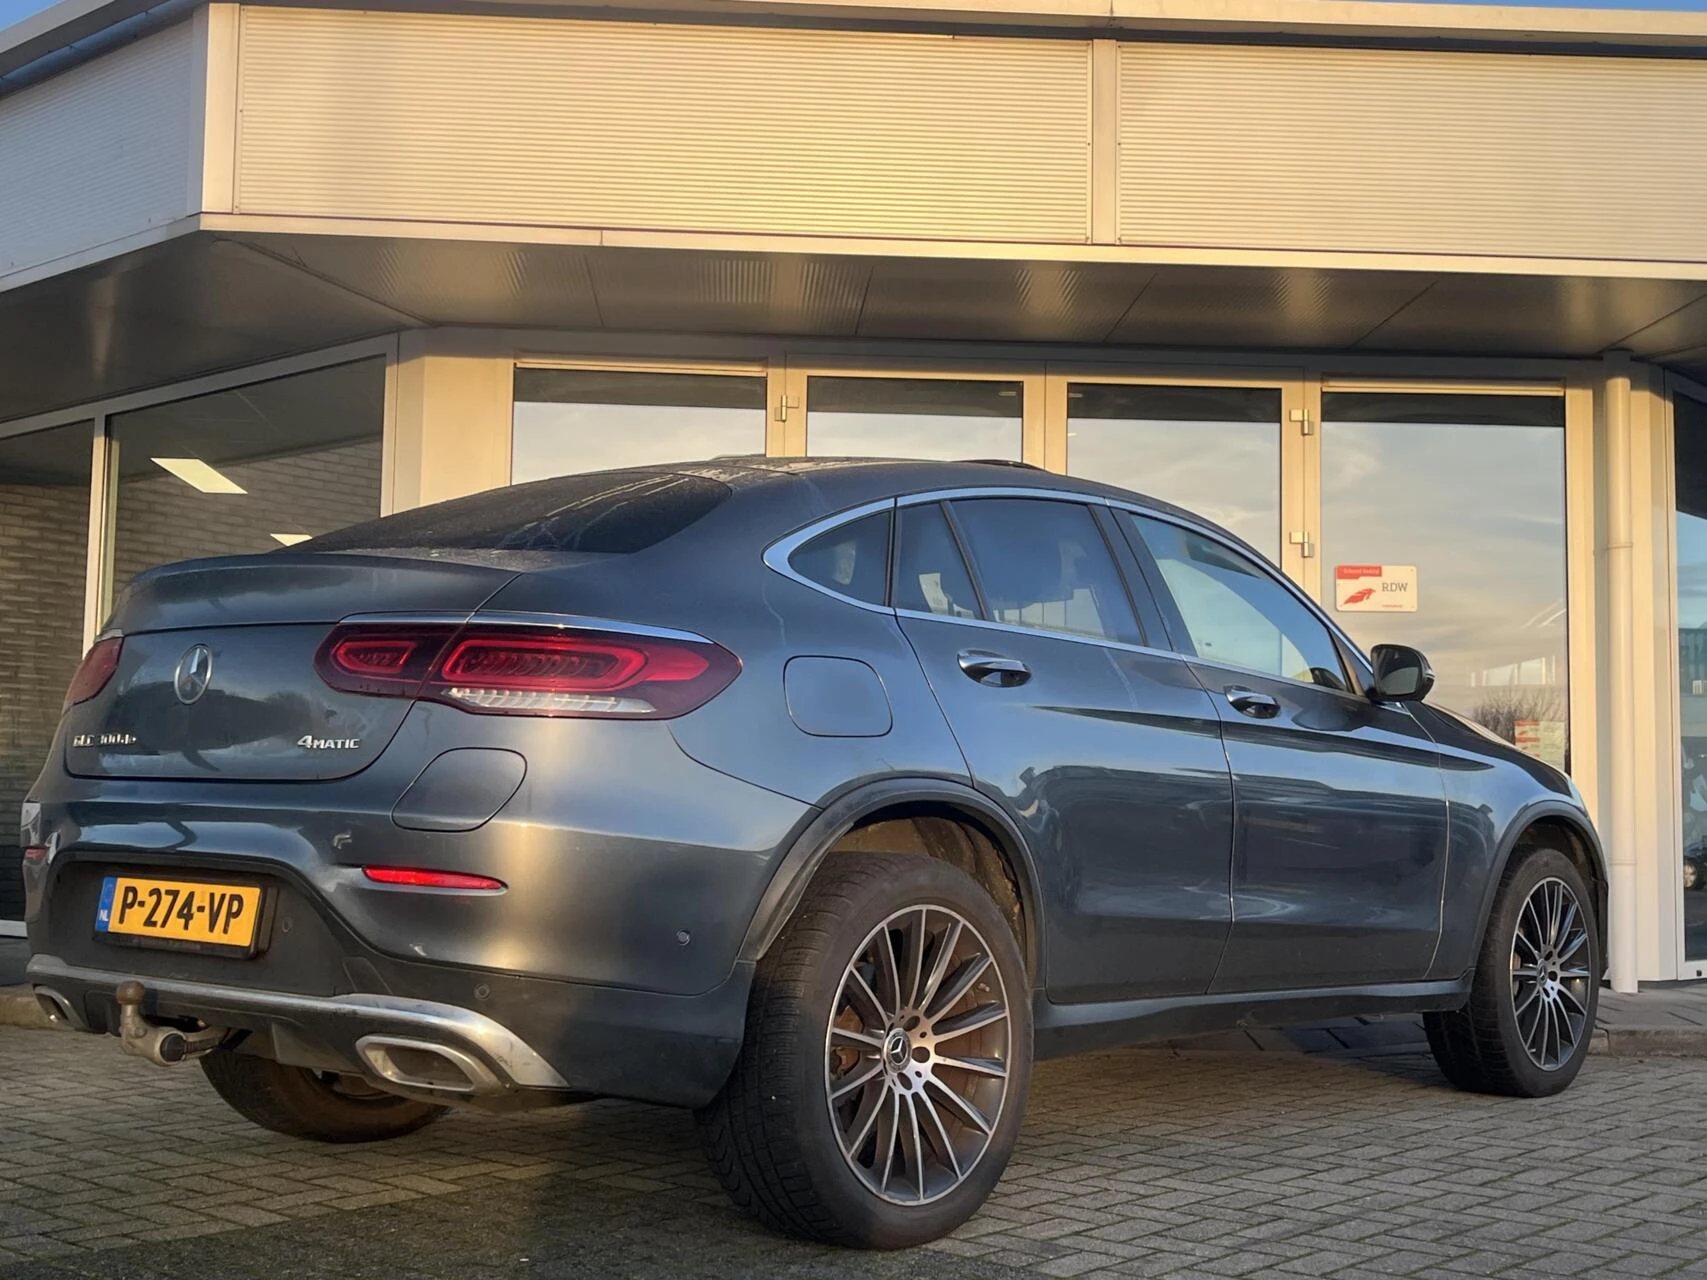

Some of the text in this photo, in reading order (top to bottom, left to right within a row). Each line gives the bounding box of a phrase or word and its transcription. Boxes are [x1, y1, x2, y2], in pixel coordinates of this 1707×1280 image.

[1382, 582, 1408, 592] RDW
[73, 734, 95, 747] GLC
[297, 735, 360, 749] 4MATIC
[99, 909, 109, 922] NL
[118, 886, 244, 935] P-274-VP
